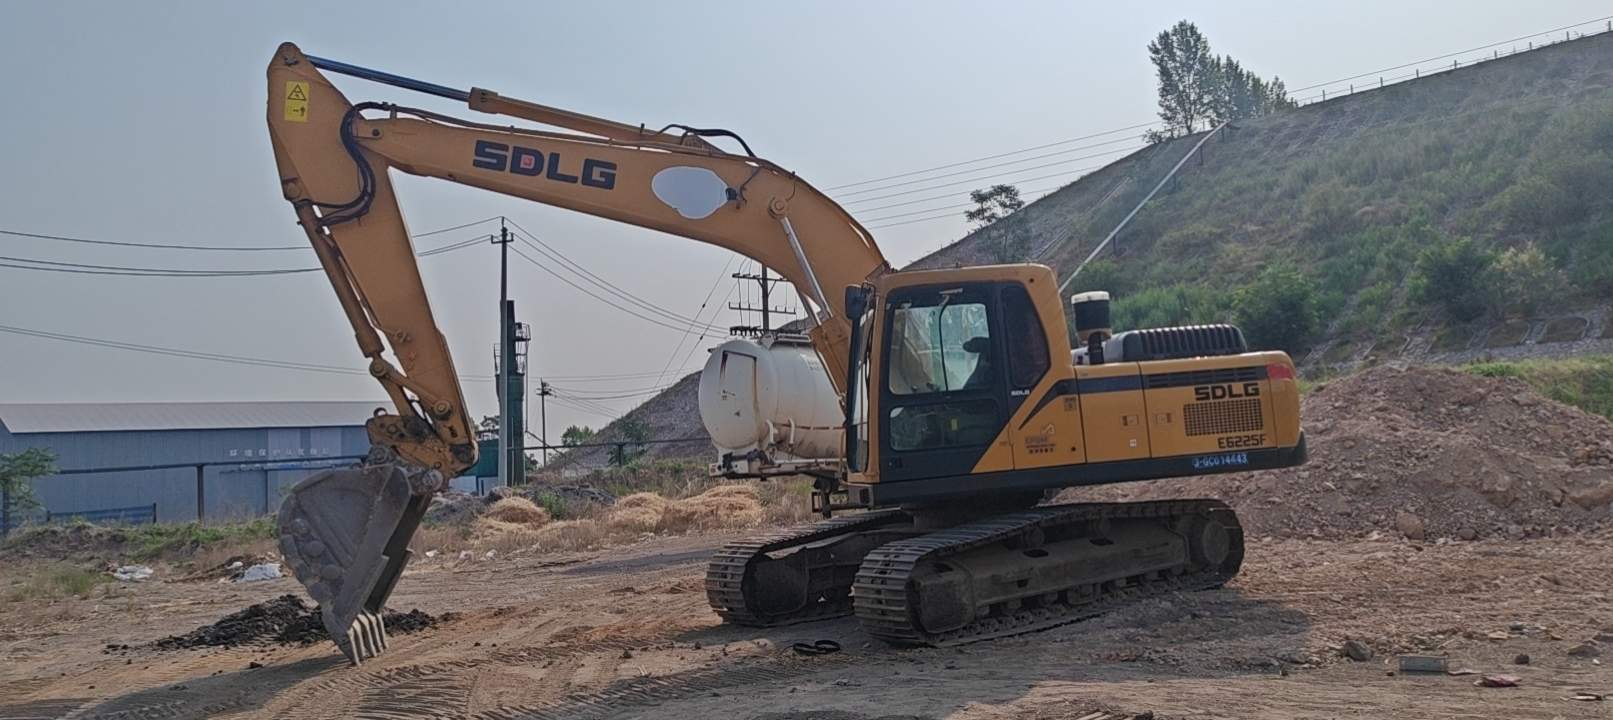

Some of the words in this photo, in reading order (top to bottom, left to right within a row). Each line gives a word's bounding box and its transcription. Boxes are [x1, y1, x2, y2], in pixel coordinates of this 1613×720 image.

[473, 139, 617, 190] SDLG
[1194, 383, 1260, 401] SDLG
[1217, 434, 1266, 448] E6225F
